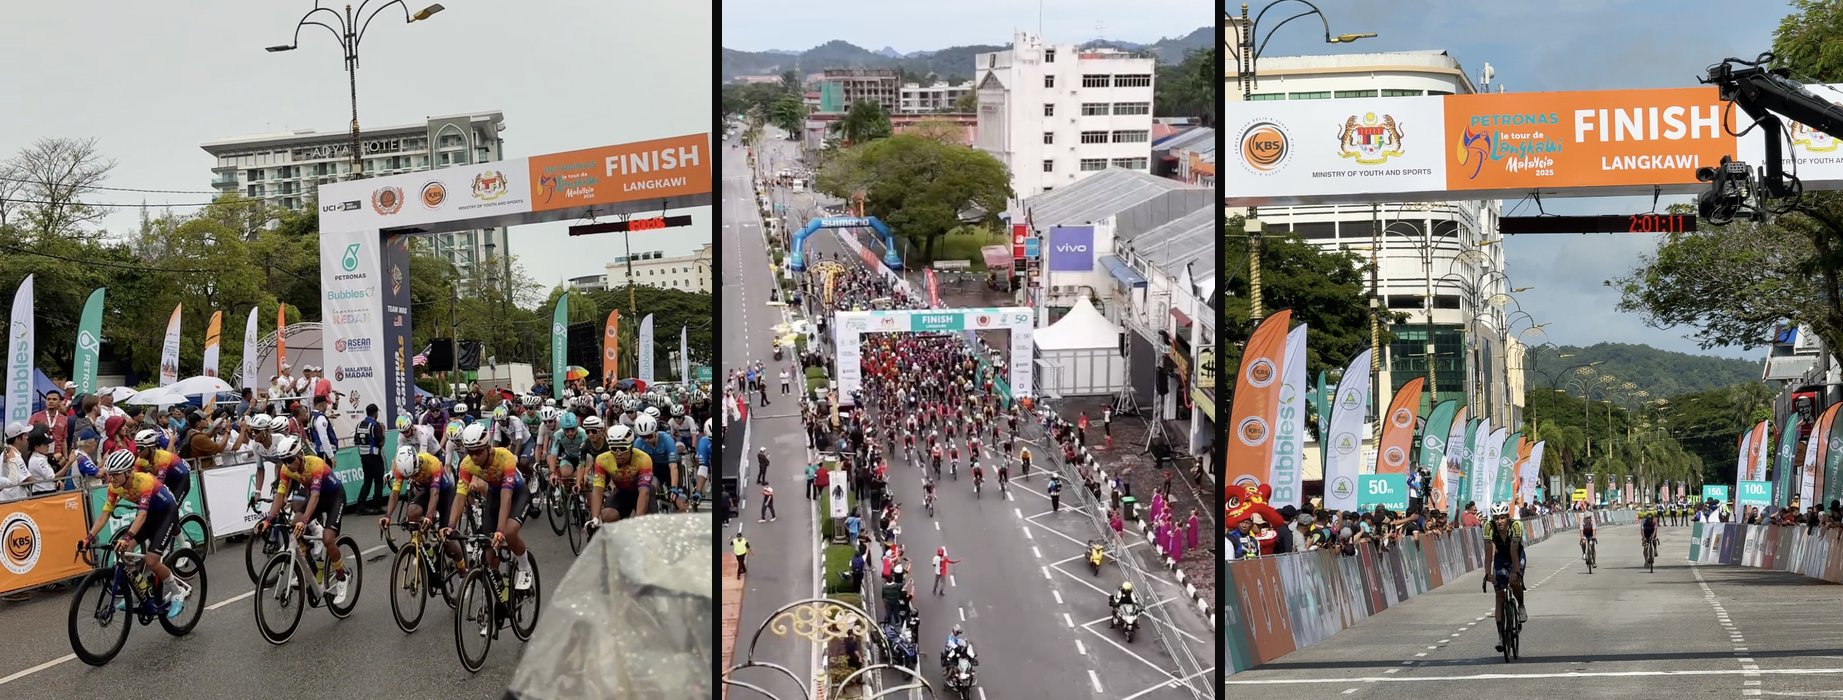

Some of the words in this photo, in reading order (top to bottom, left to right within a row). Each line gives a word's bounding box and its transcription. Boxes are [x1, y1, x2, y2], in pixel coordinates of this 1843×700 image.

[1470, 112, 1559, 127] PETRONAS
[1574, 105, 1720, 143] FINISH
[1501, 132, 1509, 140] le
[1533, 131, 1544, 139] de
[312, 145, 350, 157] ADYA
[1255, 140, 1281, 153] KBS
[1490, 130, 1563, 161] Langkawi
[605, 145, 699, 177] FINISH
[1505, 156, 1554, 173] Malaysia
[1601, 155, 1699, 171] LANGKAWI
[1402, 168, 1432, 176] SPORTS
[623, 176, 687, 192] LANGKAWI
[322, 204, 337, 213] UCI
[821, 219, 870, 227] SHIMANO
[1628, 215, 1684, 232] 2:01:11
[1056, 243, 1087, 253] vivo
[327, 290, 365, 300] Bubbles
[922, 315, 953, 324] FINISH
[347, 338, 371, 347] ASEAN
[13, 341, 30, 421] Bubbles
[1274, 406, 1296, 502] Bubbles
[335, 467, 365, 484] PETRO
[1829, 455, 1840, 499] PETRONAS
[1369, 479, 1394, 495] 50m
[1499, 468, 1508, 499] PETRONAS
[1361, 502, 1404, 510] PETNAS
[12, 535, 31, 549] KBS
